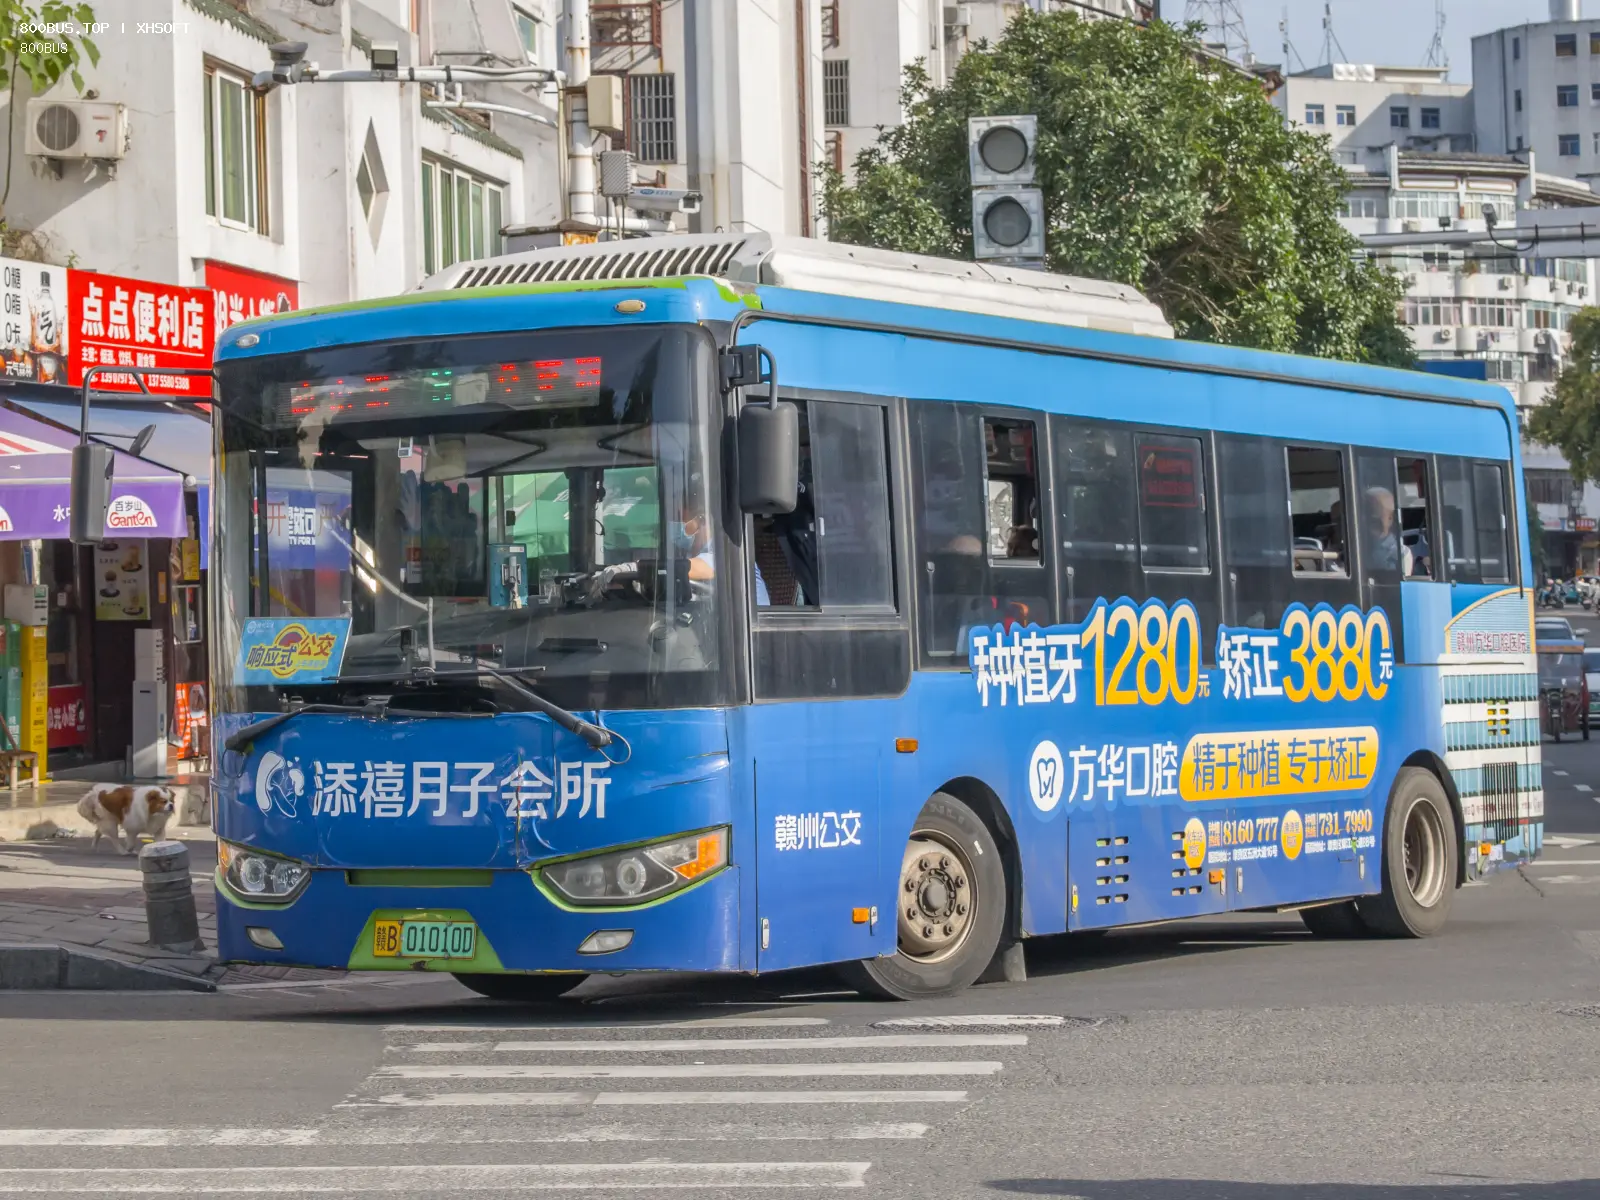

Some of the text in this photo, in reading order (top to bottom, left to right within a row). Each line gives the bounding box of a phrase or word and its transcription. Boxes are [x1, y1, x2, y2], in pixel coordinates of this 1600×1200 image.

[82, 282, 204, 349] 点点便利店
[109, 511, 152, 526] Ganten
[114, 500, 142, 512] 百岁山
[247, 645, 297, 667] 响应式
[298, 634, 336, 656] 公交
[1068, 735, 1368, 803] 方华口腔 精于种植 专于矫正
[312, 760, 613, 819] 添禧月子会所
[774, 810, 862, 851] 赣州公交
[1223, 818, 1254, 845] 8160
[1256, 816, 1279, 842] 777
[1319, 811, 1340, 836] 731
